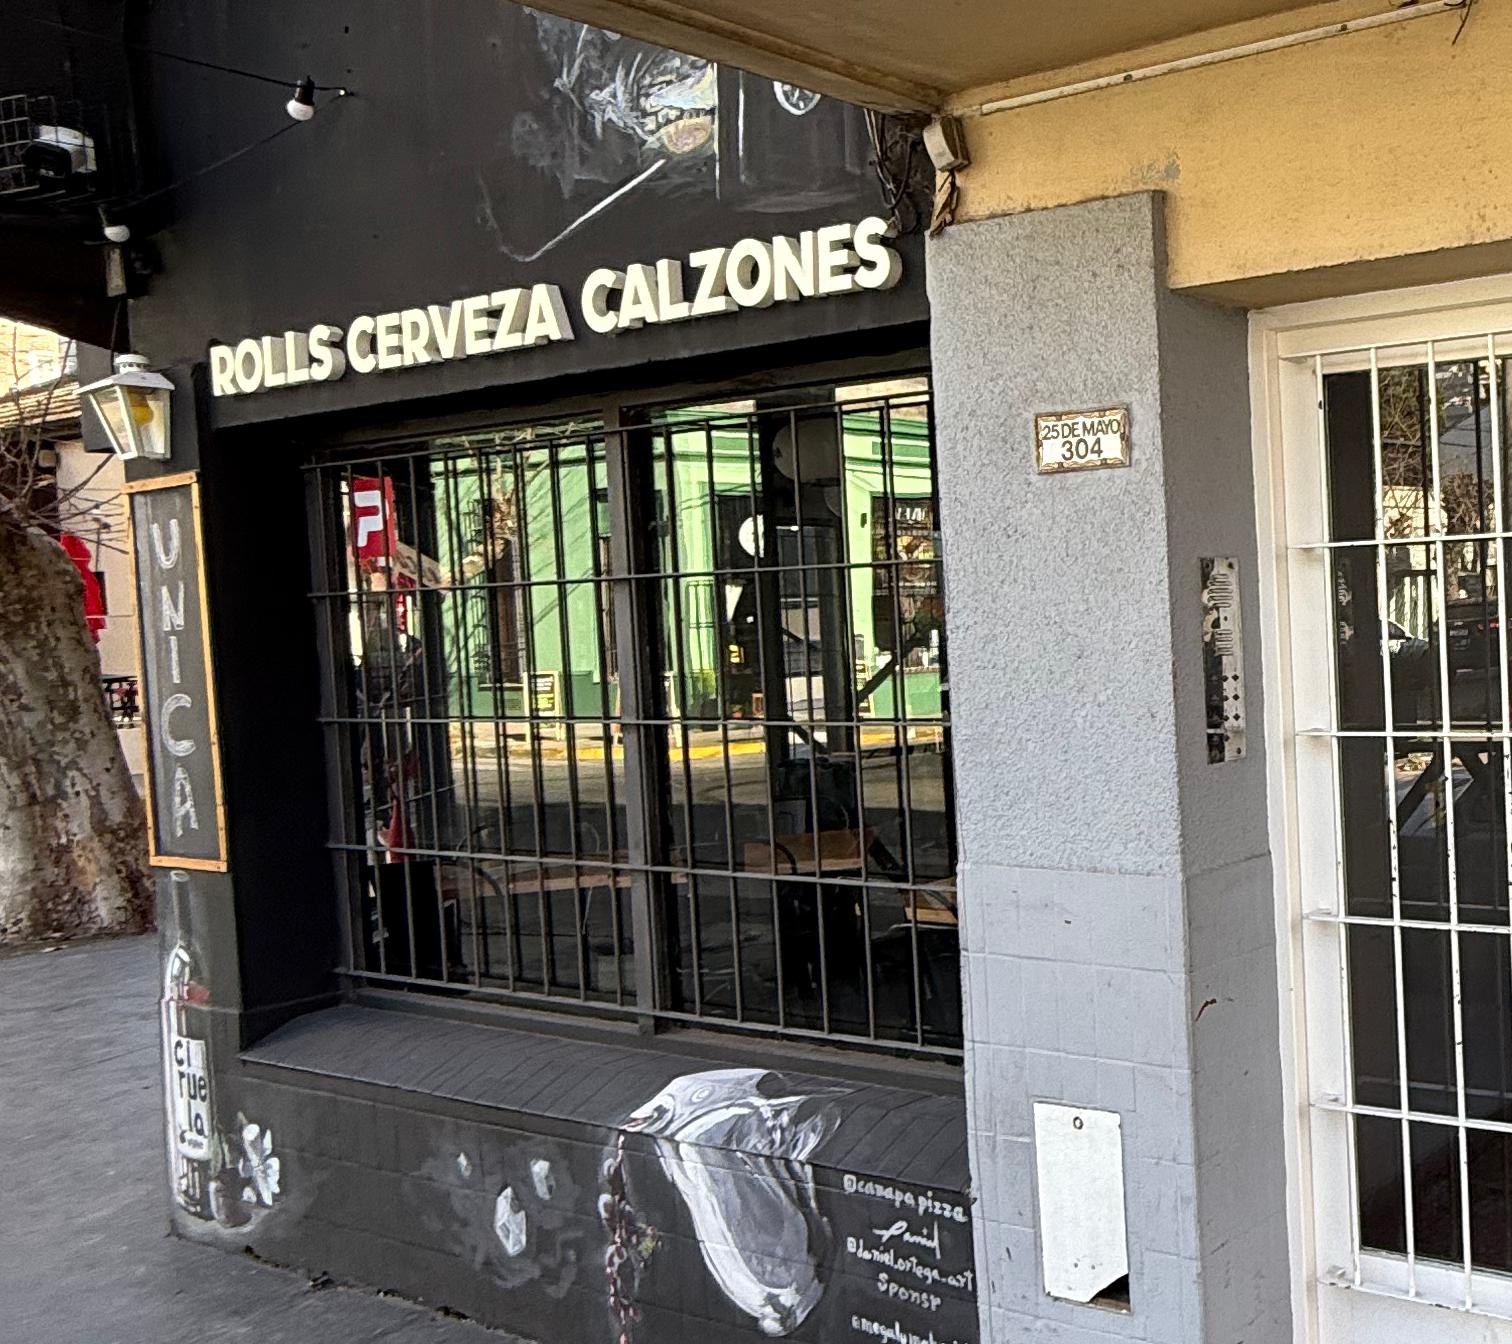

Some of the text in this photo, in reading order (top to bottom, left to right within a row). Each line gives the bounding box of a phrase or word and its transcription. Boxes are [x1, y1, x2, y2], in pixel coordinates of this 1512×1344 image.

[210, 216, 902, 397] ROLLS CERVEZA CALZONES
[1041, 418, 1120, 440] 25 DE MAYO
[1061, 437, 1103, 460] 304
[151, 518, 200, 838] UNICA
